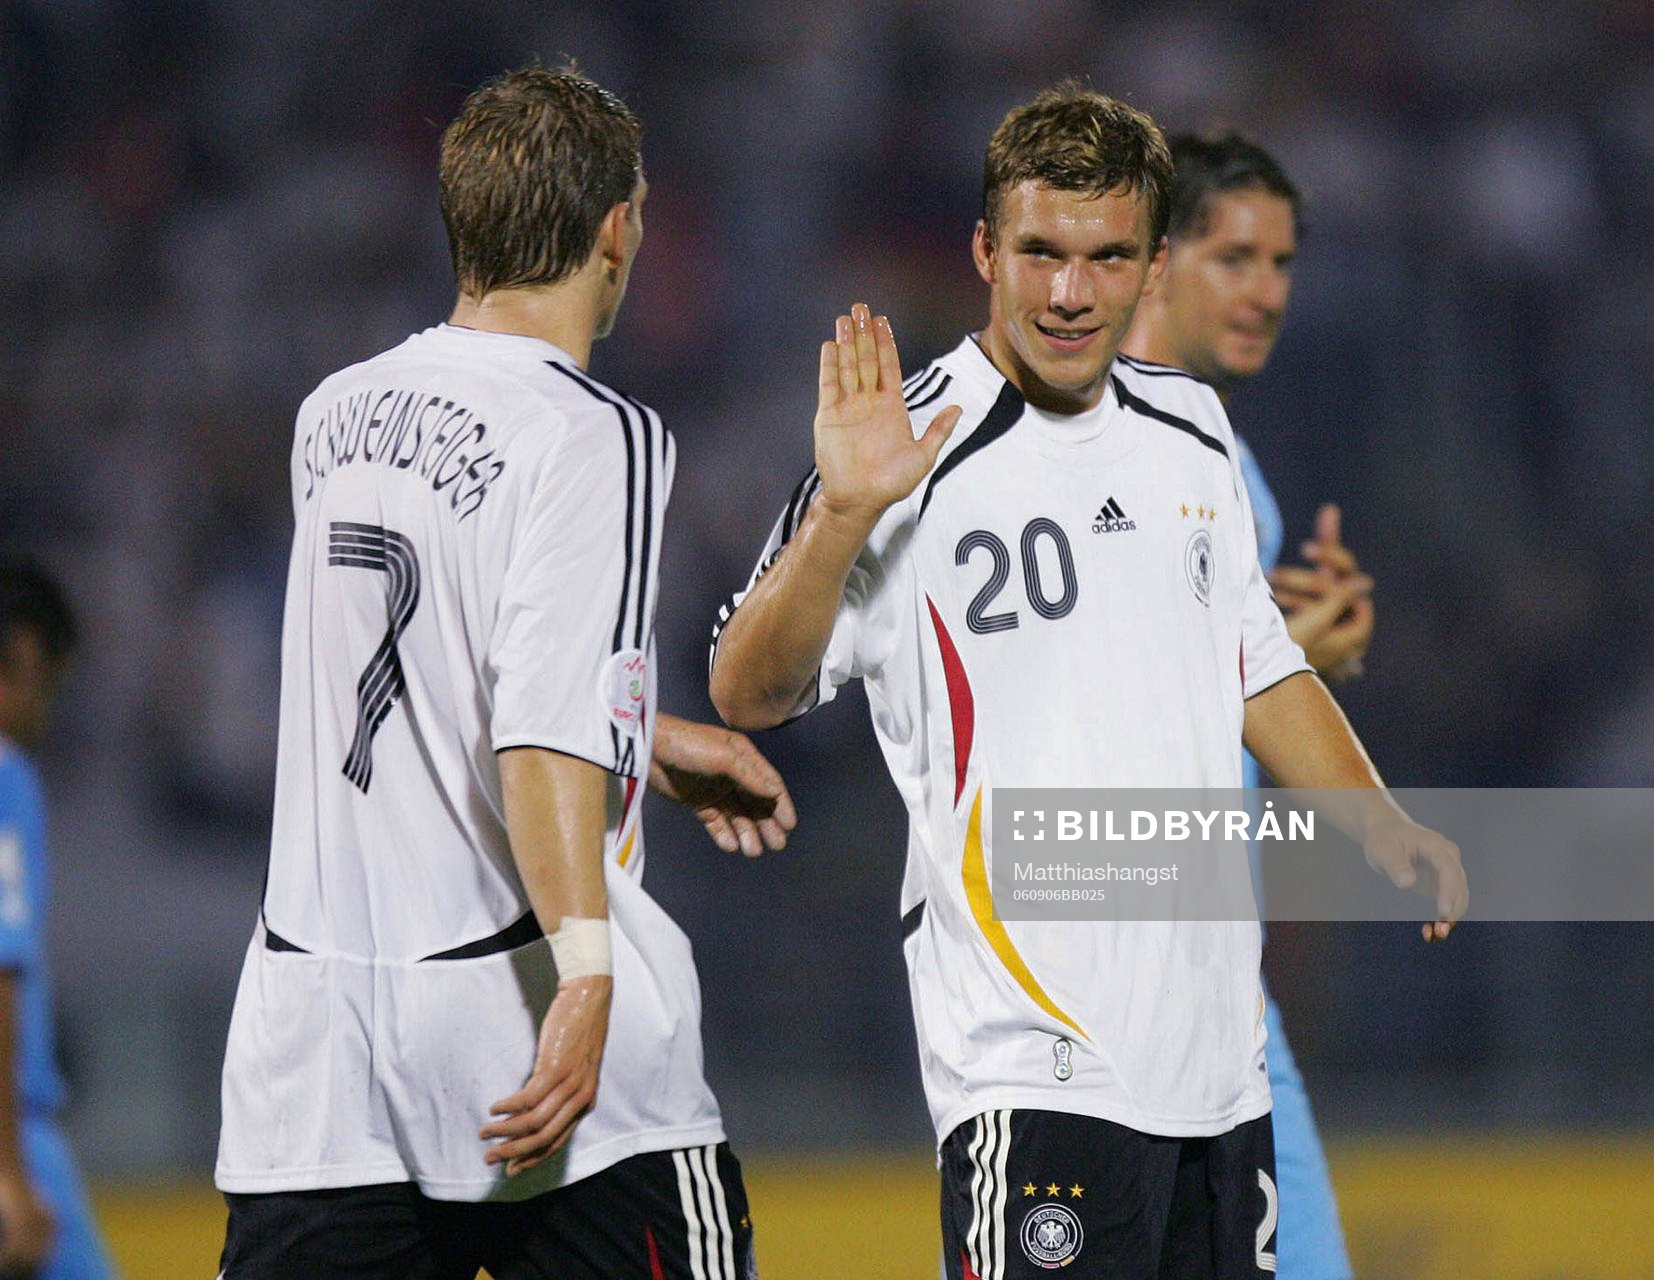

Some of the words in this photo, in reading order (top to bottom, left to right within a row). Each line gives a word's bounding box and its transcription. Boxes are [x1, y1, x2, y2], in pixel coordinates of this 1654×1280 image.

[304, 389, 506, 522] SCHWEINSTEIGER
[955, 517, 1079, 635] 20
[1091, 518, 1137, 535] adidas
[328, 521, 421, 796] 7
